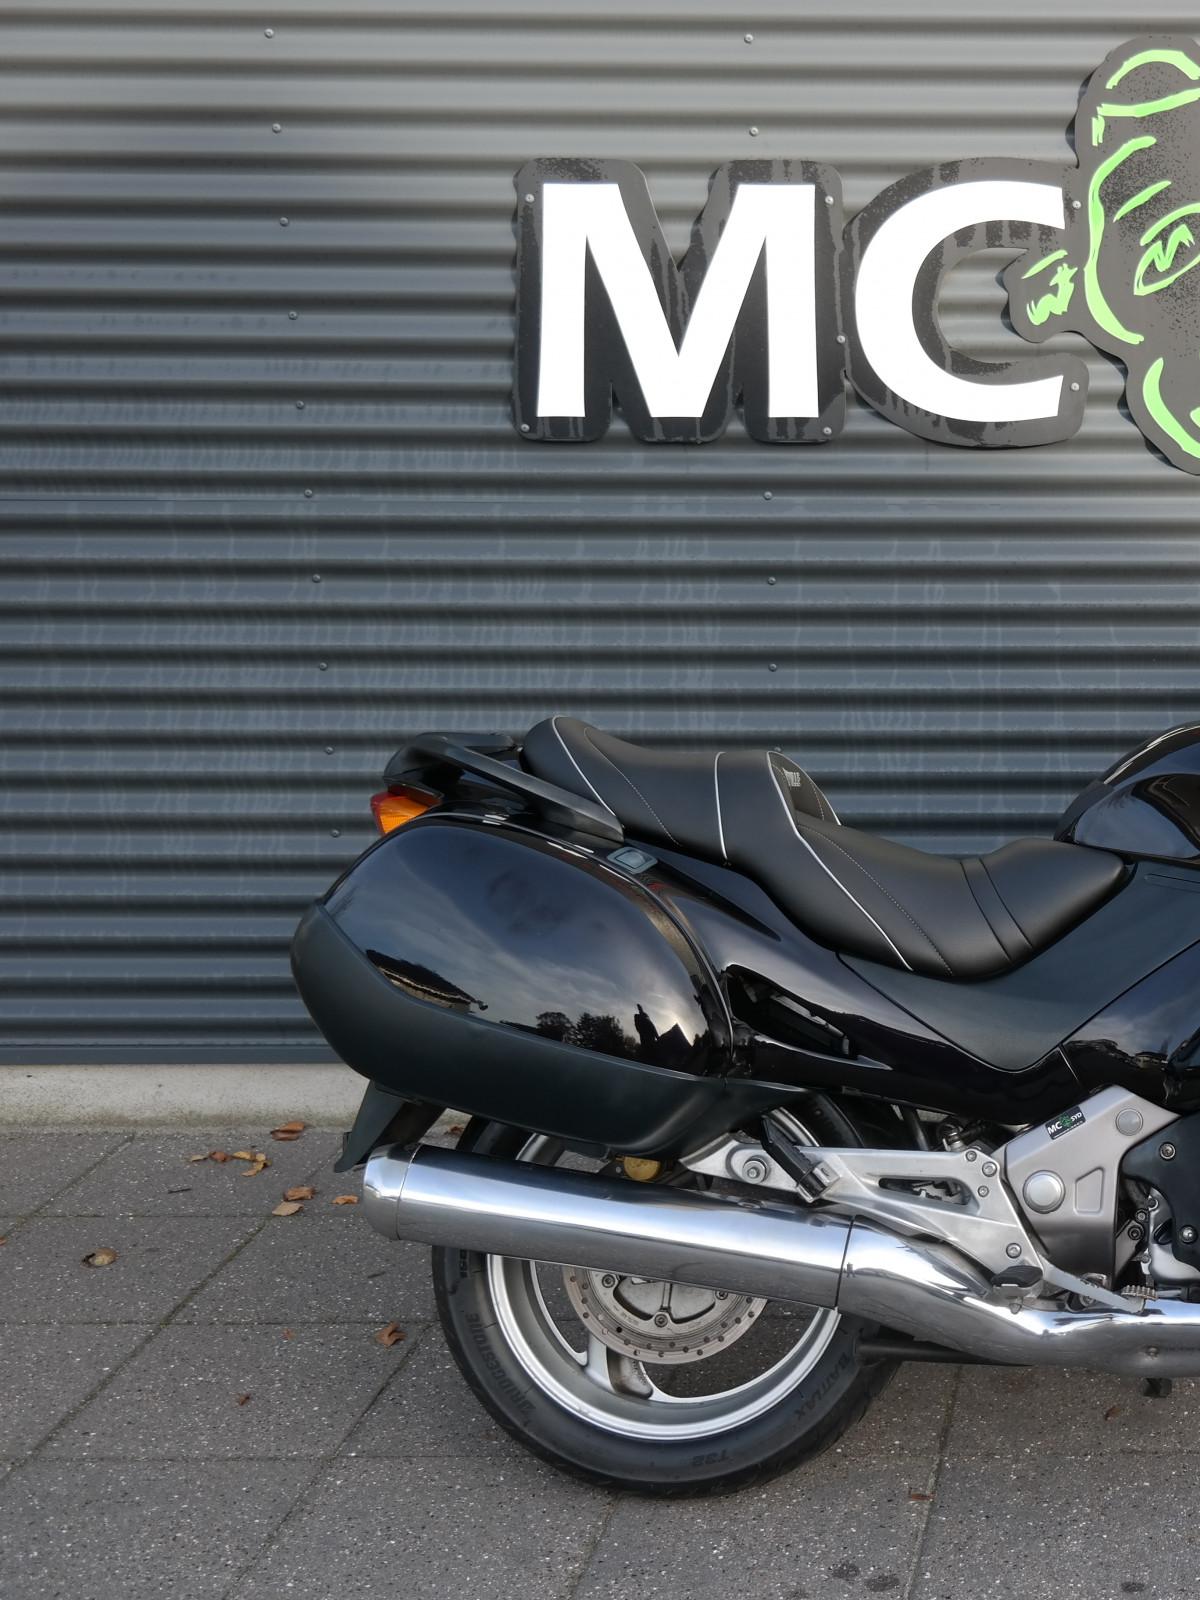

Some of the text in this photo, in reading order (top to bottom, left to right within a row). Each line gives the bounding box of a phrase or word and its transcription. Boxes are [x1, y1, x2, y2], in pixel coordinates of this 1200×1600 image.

[536, 180, 1066, 422] MC
[1047, 1121, 1063, 1134] MC
[1070, 1112, 1082, 1122] SYD
